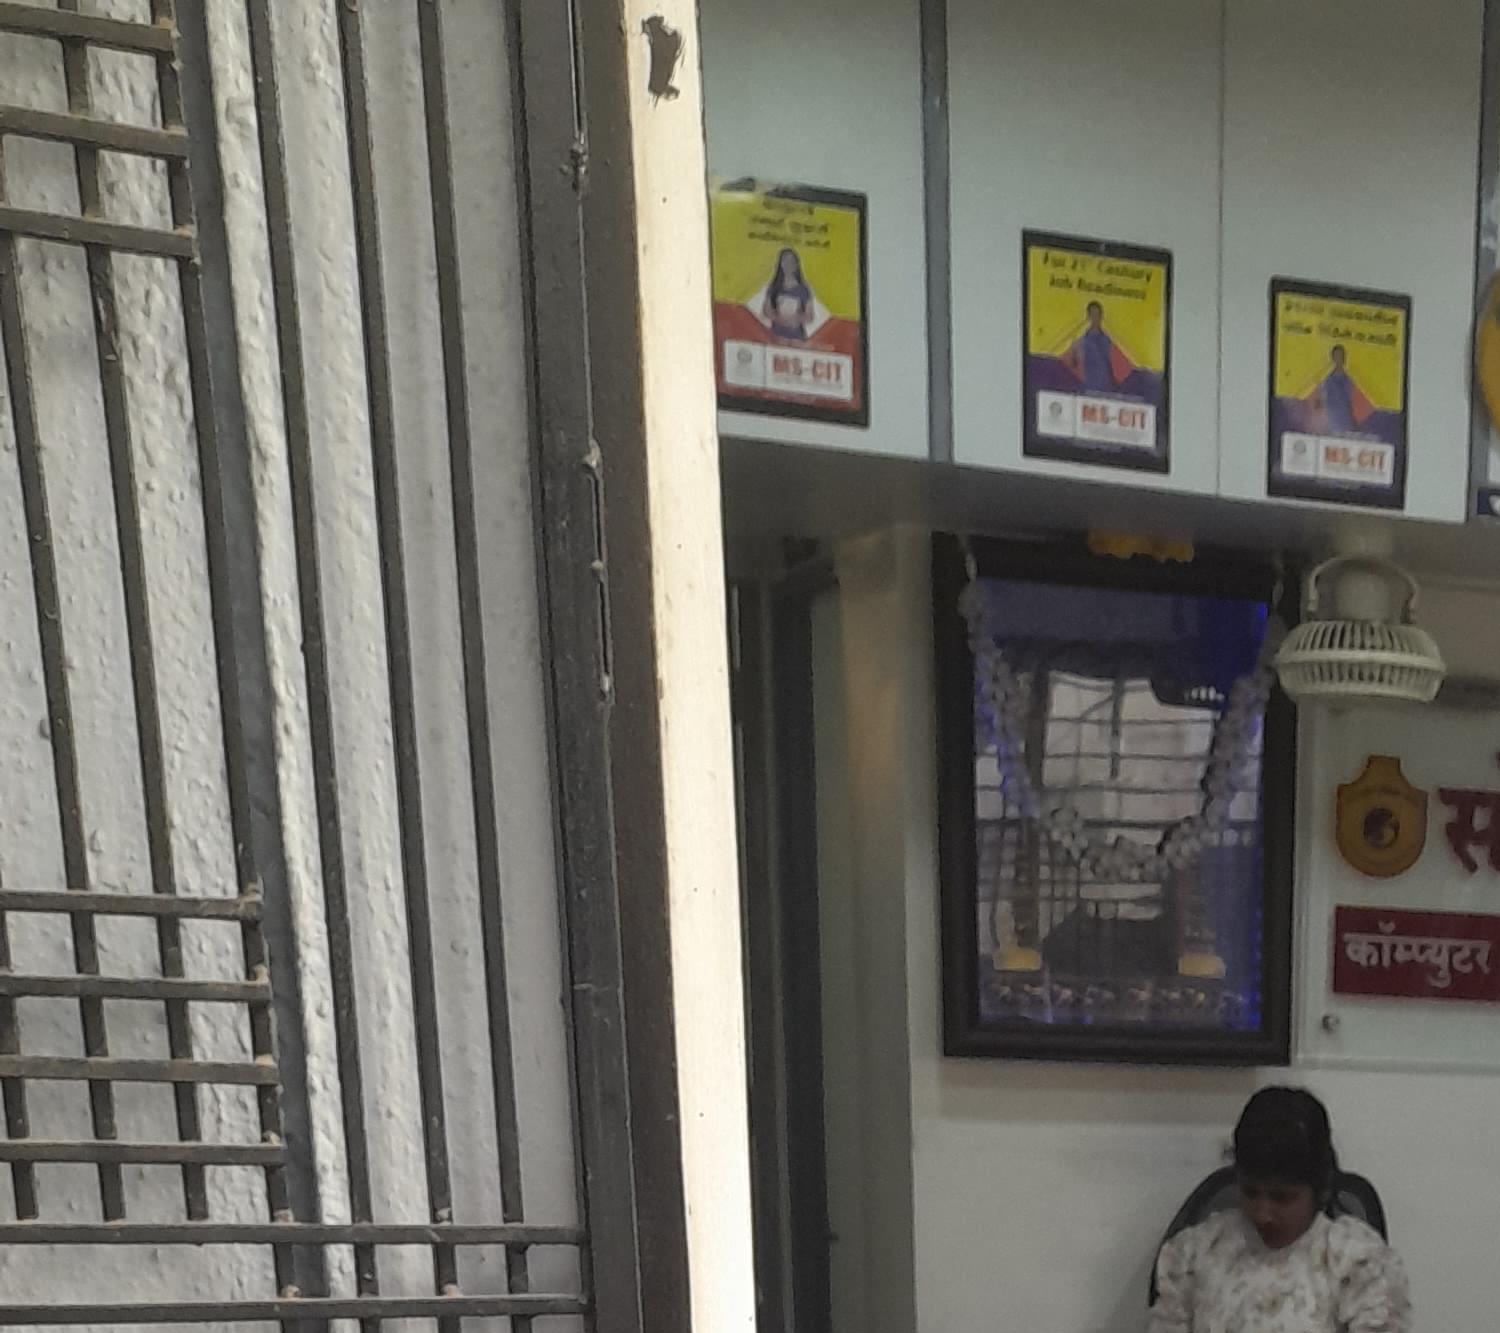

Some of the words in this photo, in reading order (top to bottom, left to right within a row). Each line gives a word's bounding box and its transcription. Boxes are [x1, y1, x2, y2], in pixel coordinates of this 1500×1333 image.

[774, 353, 843, 383] MS-CIT
[1082, 402, 1147, 431] MS-CIT
[1324, 446, 1387, 472] MS-CIT
